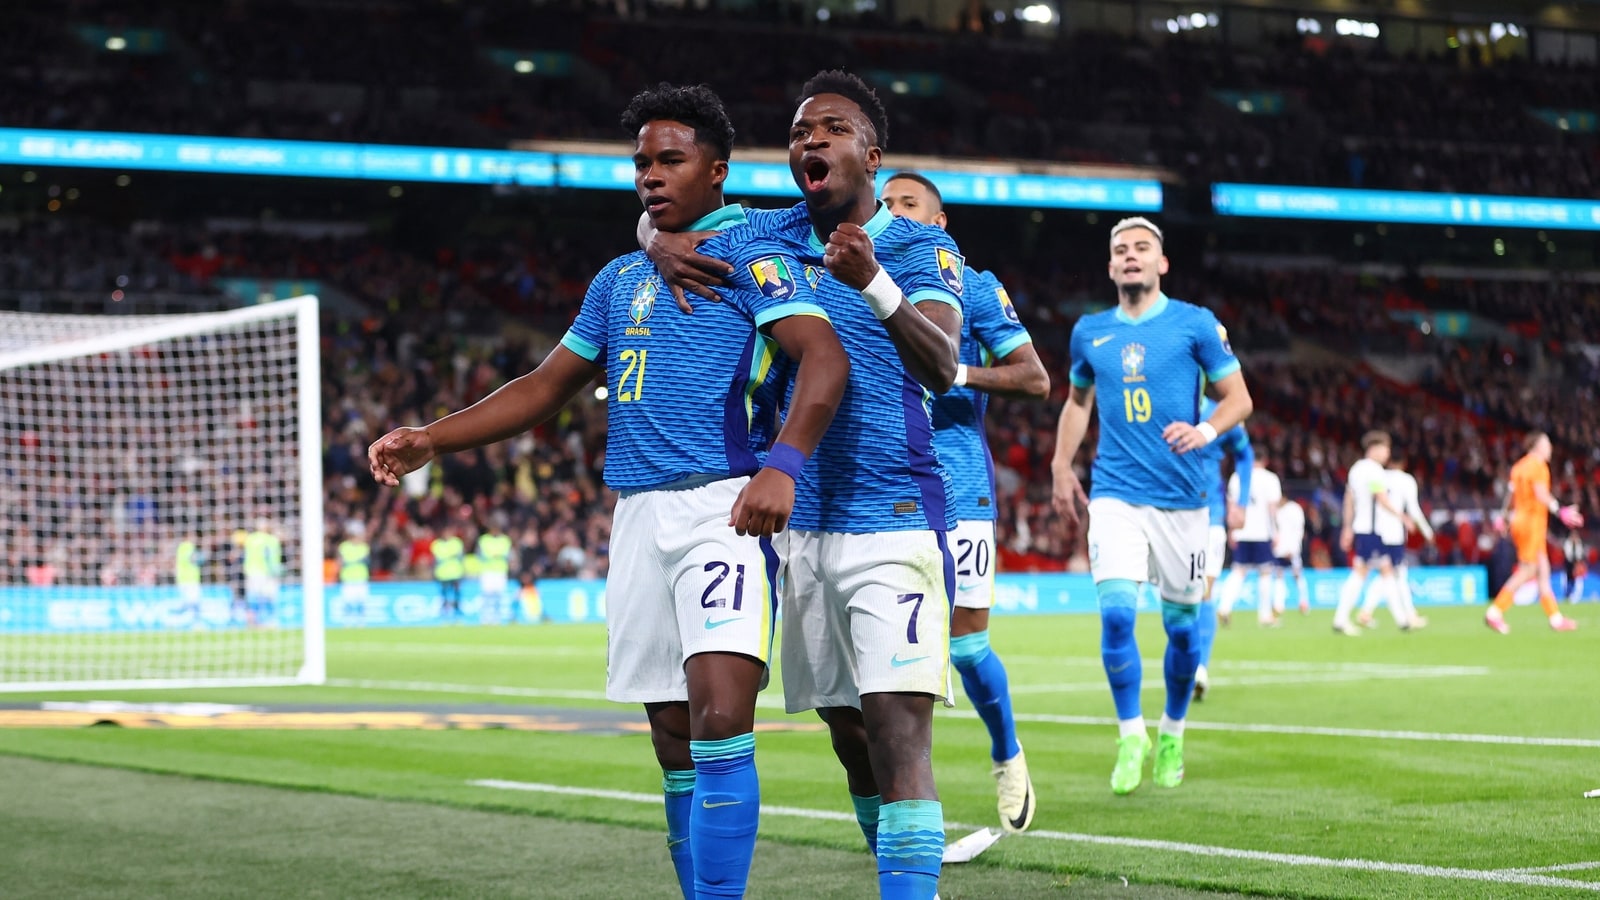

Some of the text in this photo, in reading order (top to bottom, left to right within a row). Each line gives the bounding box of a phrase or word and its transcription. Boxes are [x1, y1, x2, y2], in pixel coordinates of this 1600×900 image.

[625, 327, 651, 336] BRASIL
[617, 349, 647, 402] 21
[1123, 388, 1152, 423] 19
[957, 539, 989, 577] 20
[701, 561, 745, 611] 21
[897, 593, 924, 644] 7
